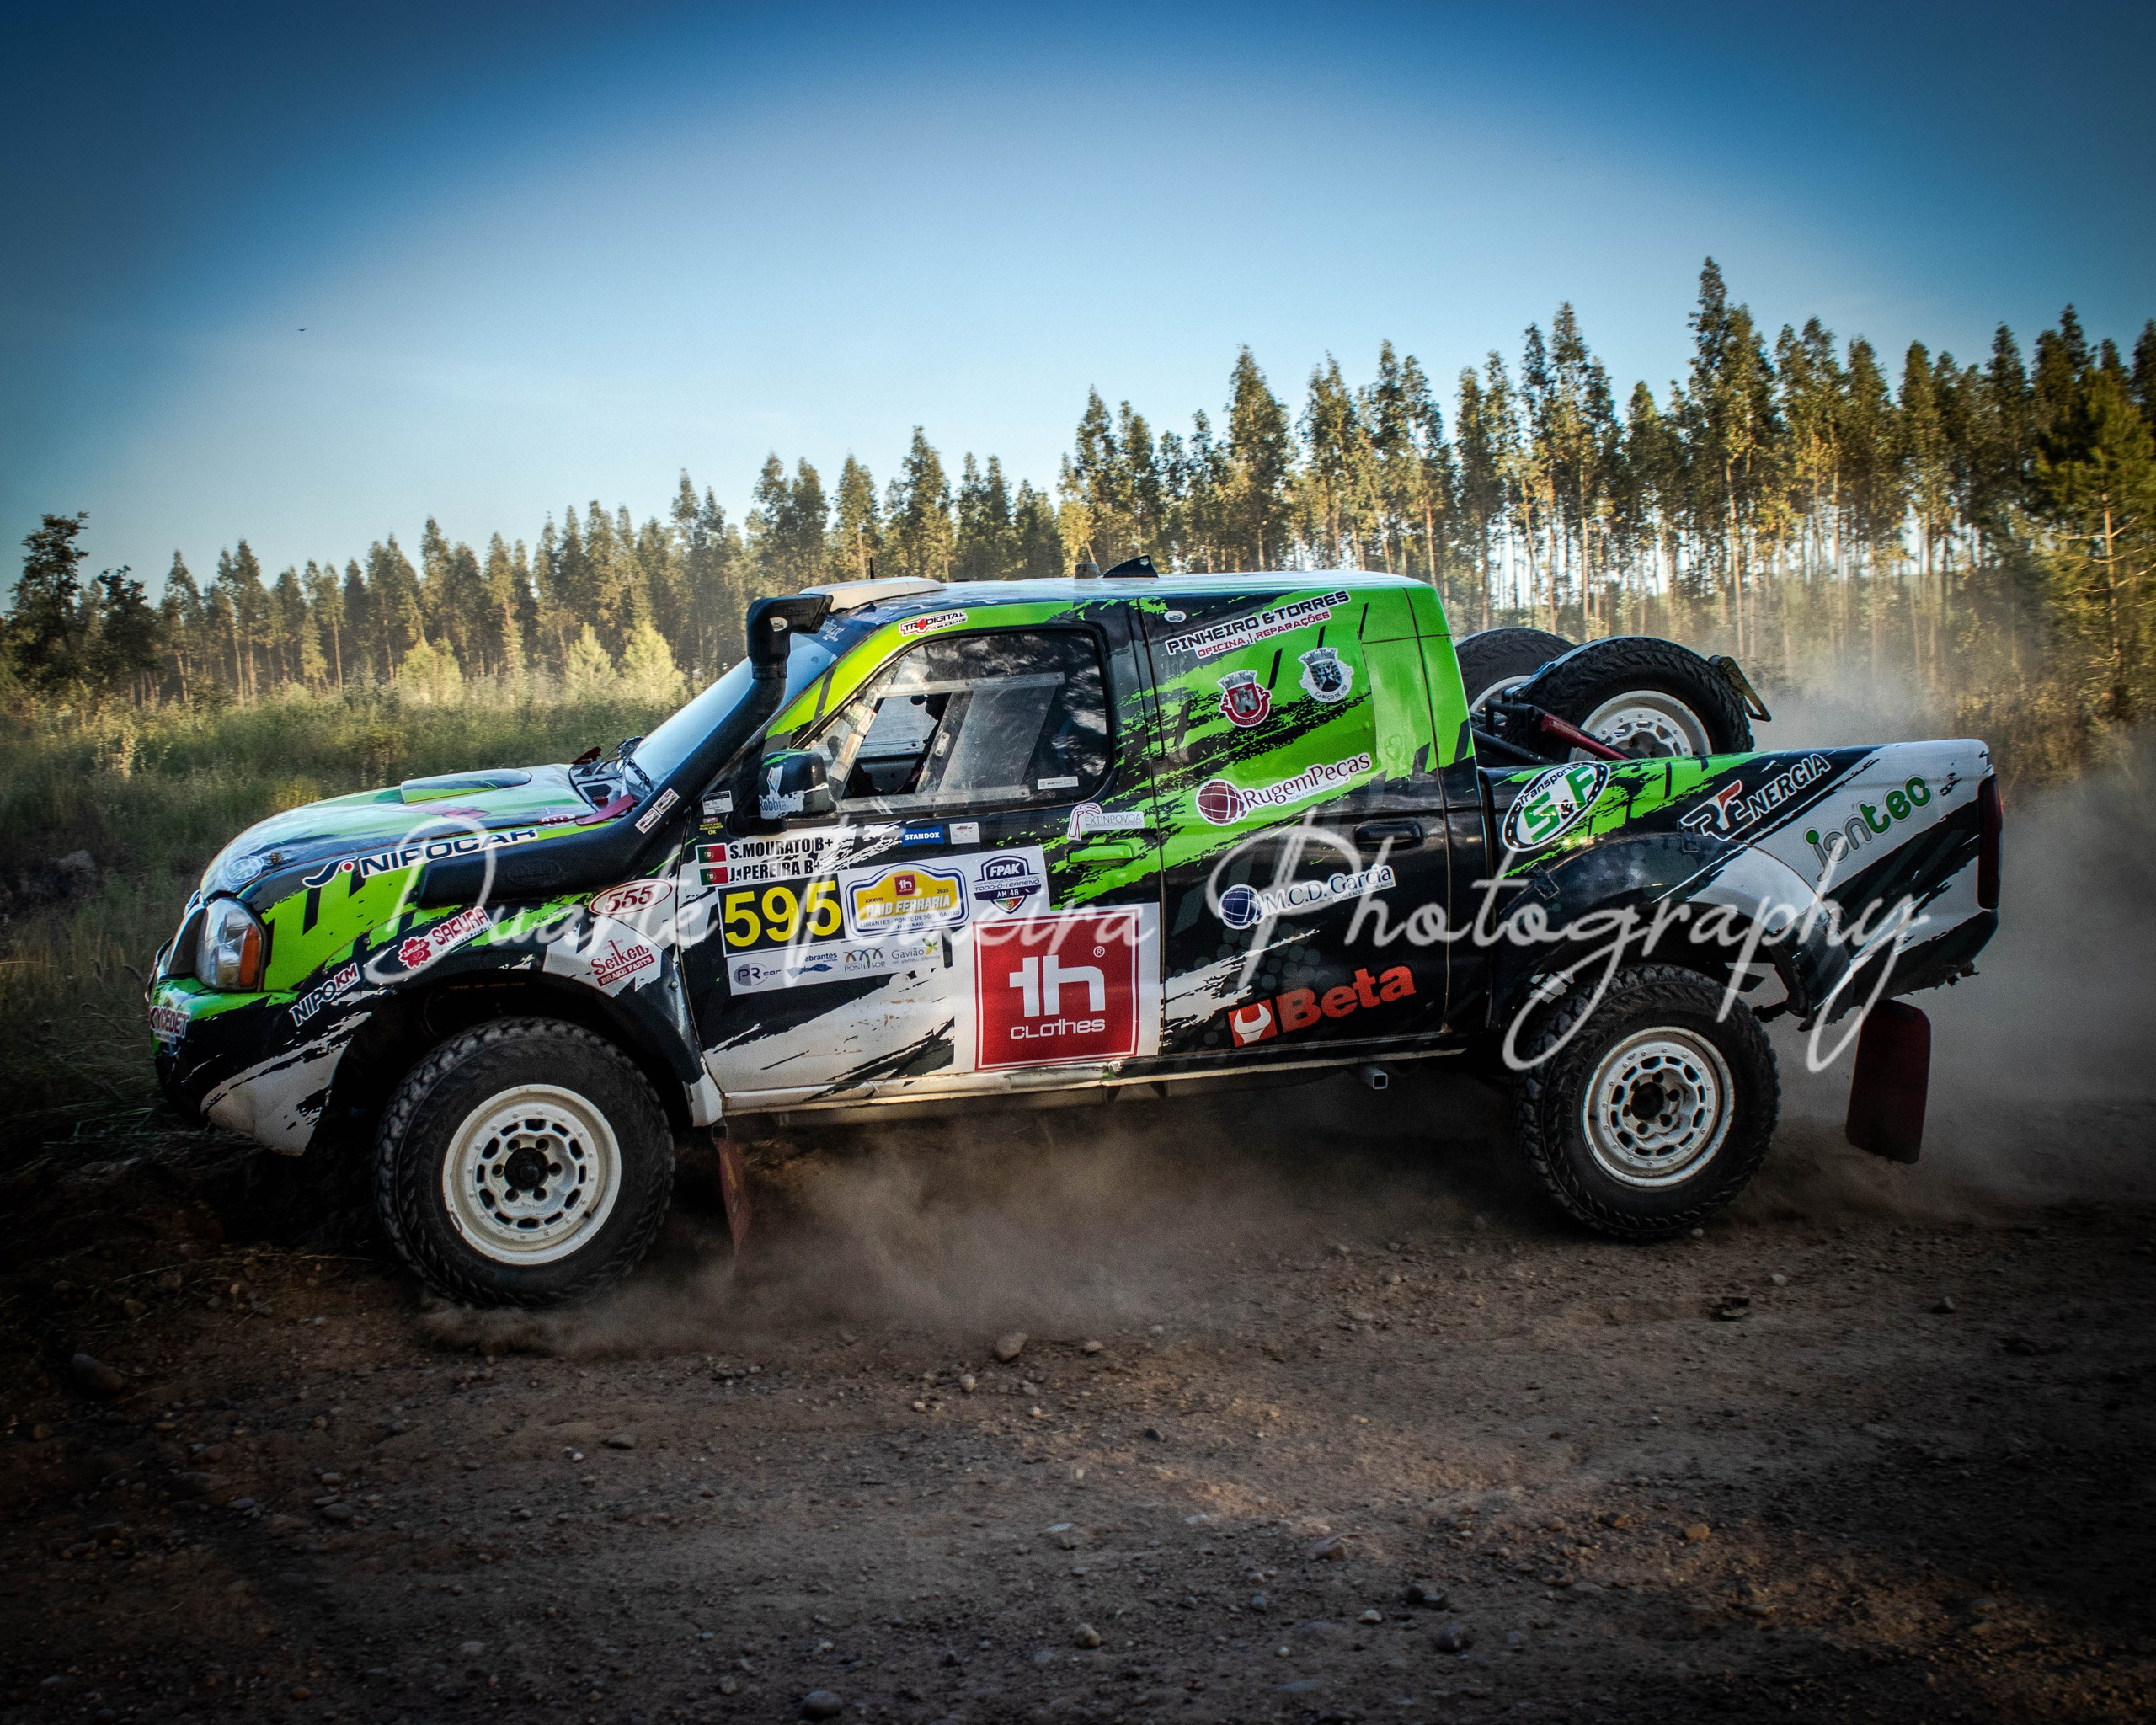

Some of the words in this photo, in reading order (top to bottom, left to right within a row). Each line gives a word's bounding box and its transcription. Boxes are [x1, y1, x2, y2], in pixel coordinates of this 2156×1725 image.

[1166, 615, 1259, 654] PINHEIRO
[1198, 638, 1245, 658] OFICINA
[1257, 611, 1330, 640] REPARAÇÕES
[1241, 754, 1371, 809] RugemPeças
[759, 795, 801, 812] Robbial
[1085, 813, 1143, 825] EXTINPÓVOA
[905, 832, 940, 841] STANDOX
[360, 830, 537, 877] NIPOCAR
[729, 838, 811, 860] S.MOURATO
[814, 837, 834, 852] B+
[729, 861, 800, 882] J.PEREIRA
[804, 859, 822, 874] B+
[990, 862, 1021, 877] FPAK
[975, 879, 1040, 891] TODO-O-TERRENO
[1264, 882, 1328, 914] M.C.D.
[1329, 864, 1393, 891] Garcia
[605, 884, 657, 912] 555
[866, 902, 893, 917] RAID
[896, 895, 951, 914] FERRARIA
[723, 880, 843, 947] 595
[859, 919, 890, 927] ABRANTES
[431, 909, 489, 946] SAKURA
[403, 942, 426, 958] SAKURA
[591, 939, 649, 975] Seiken
[804, 953, 838, 962] abrantes
[892, 947, 925, 959] Gavião
[600, 967, 627, 985] BRAKE
[628, 956, 652, 972] PARTS
[872, 961, 886, 969] SOR
[1276, 965, 1417, 1033] Beta
